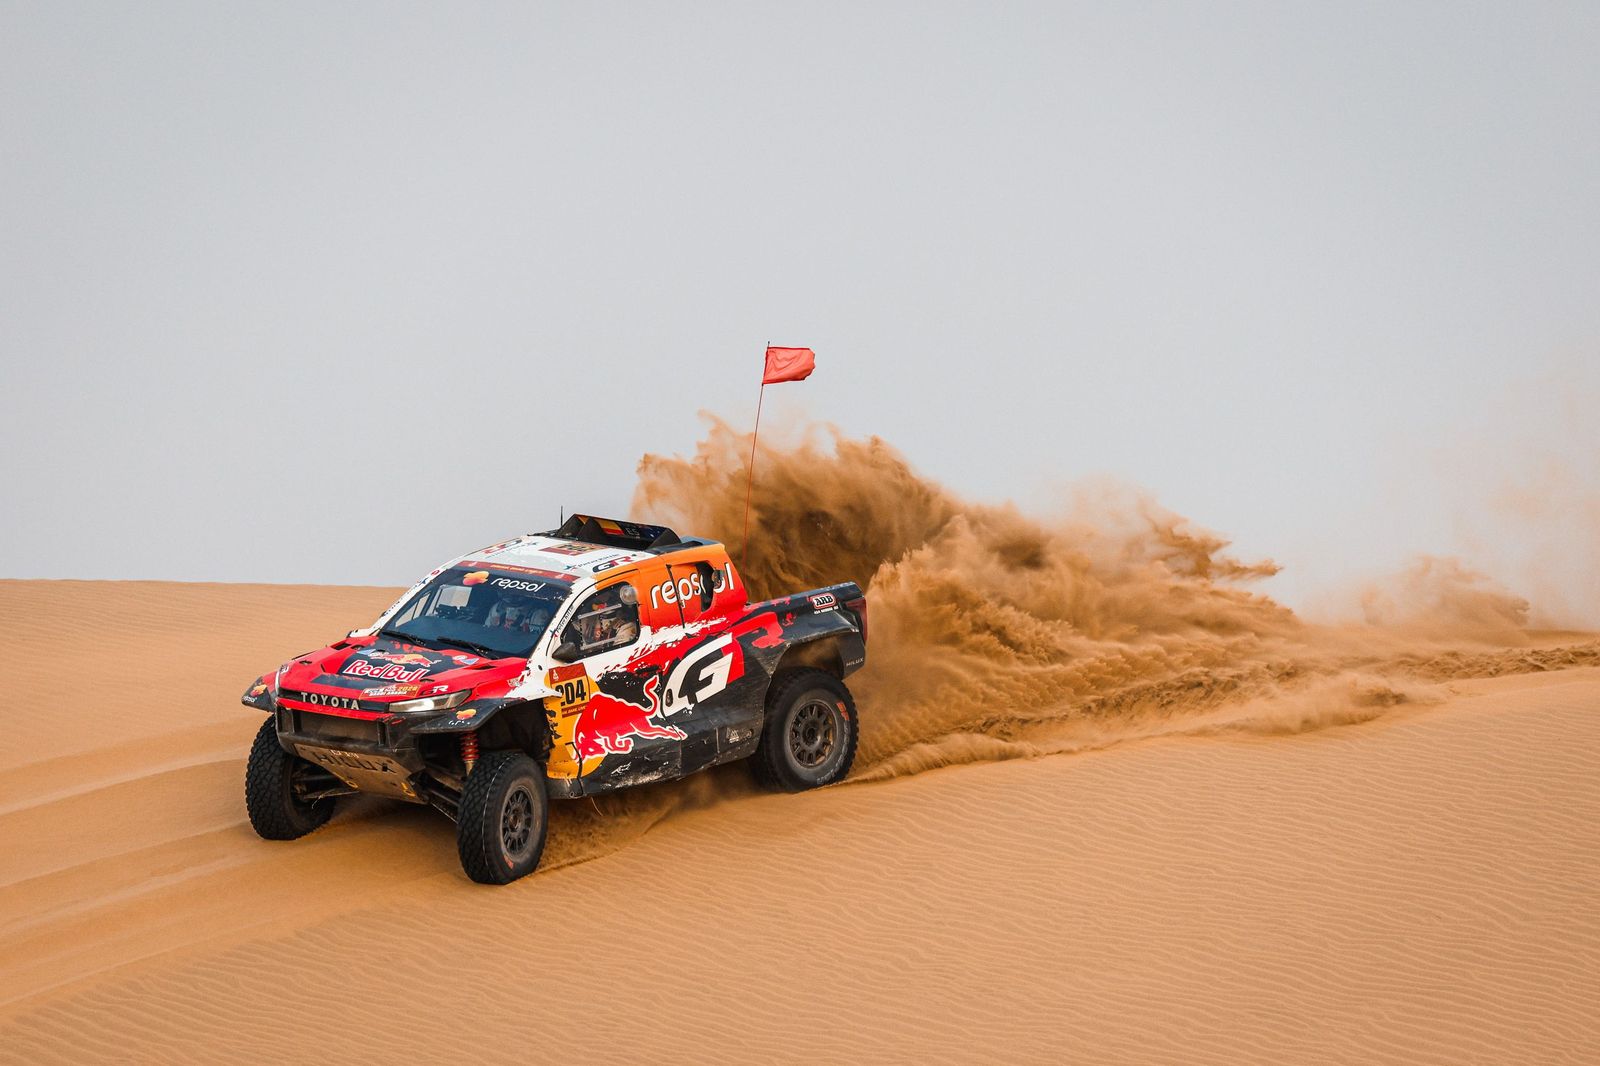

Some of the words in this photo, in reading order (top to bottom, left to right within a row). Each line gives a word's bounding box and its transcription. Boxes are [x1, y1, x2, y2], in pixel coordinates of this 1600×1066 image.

[490, 577, 547, 593] repsol
[814, 595, 833, 606] ARB
[301, 691, 360, 711] TOYOTA
[554, 678, 587, 706] 204
